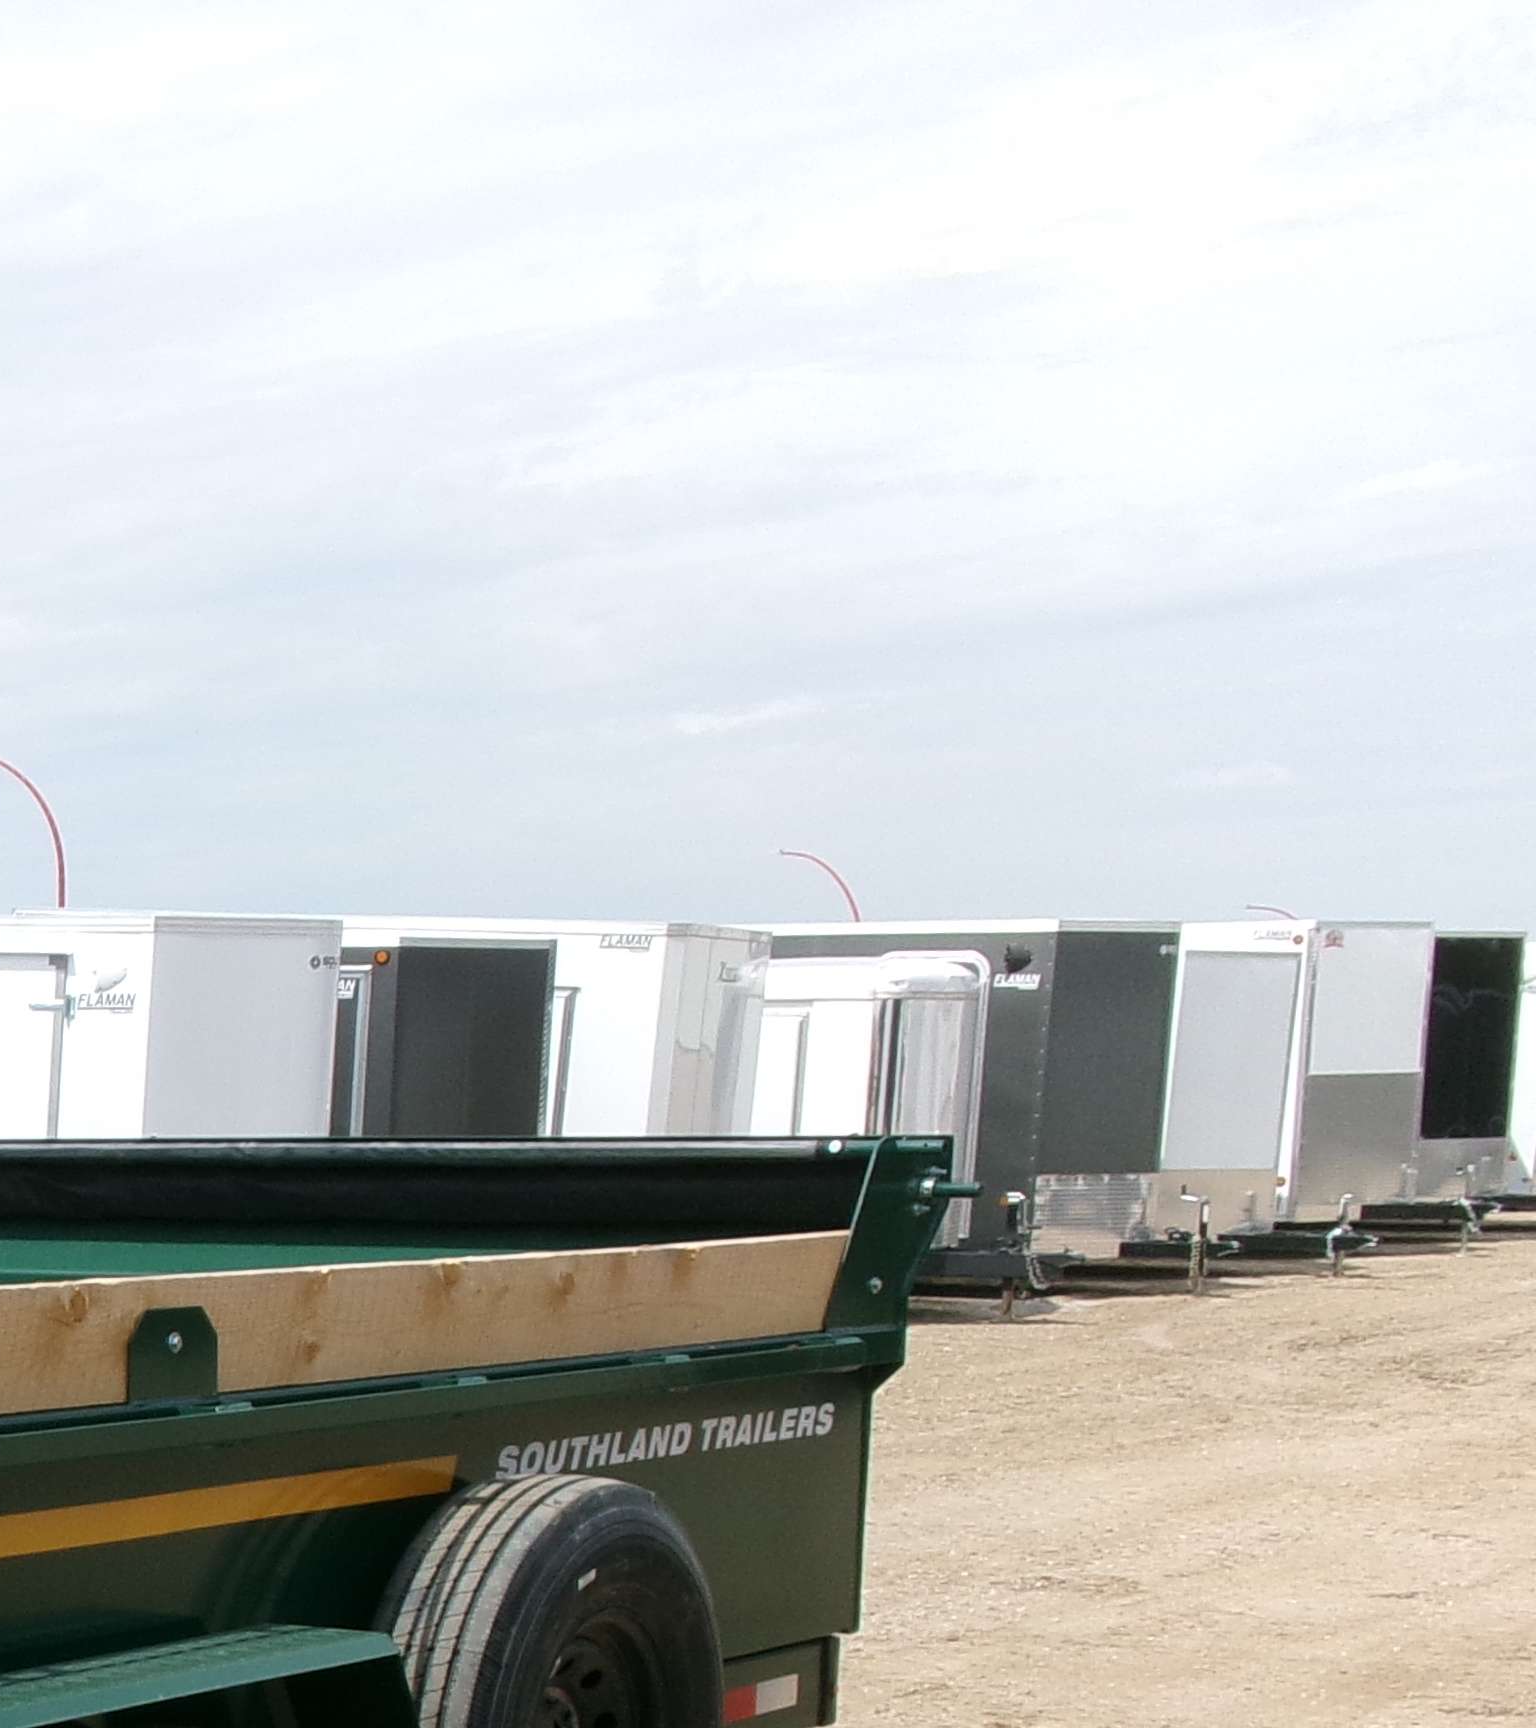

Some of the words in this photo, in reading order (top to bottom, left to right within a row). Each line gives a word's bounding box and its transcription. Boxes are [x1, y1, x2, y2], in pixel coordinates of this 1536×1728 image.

[78, 993, 137, 1007] FLAMAN
[495, 1422, 693, 1480] SOUTHLAND
[701, 1402, 836, 1452] TRAILERS
